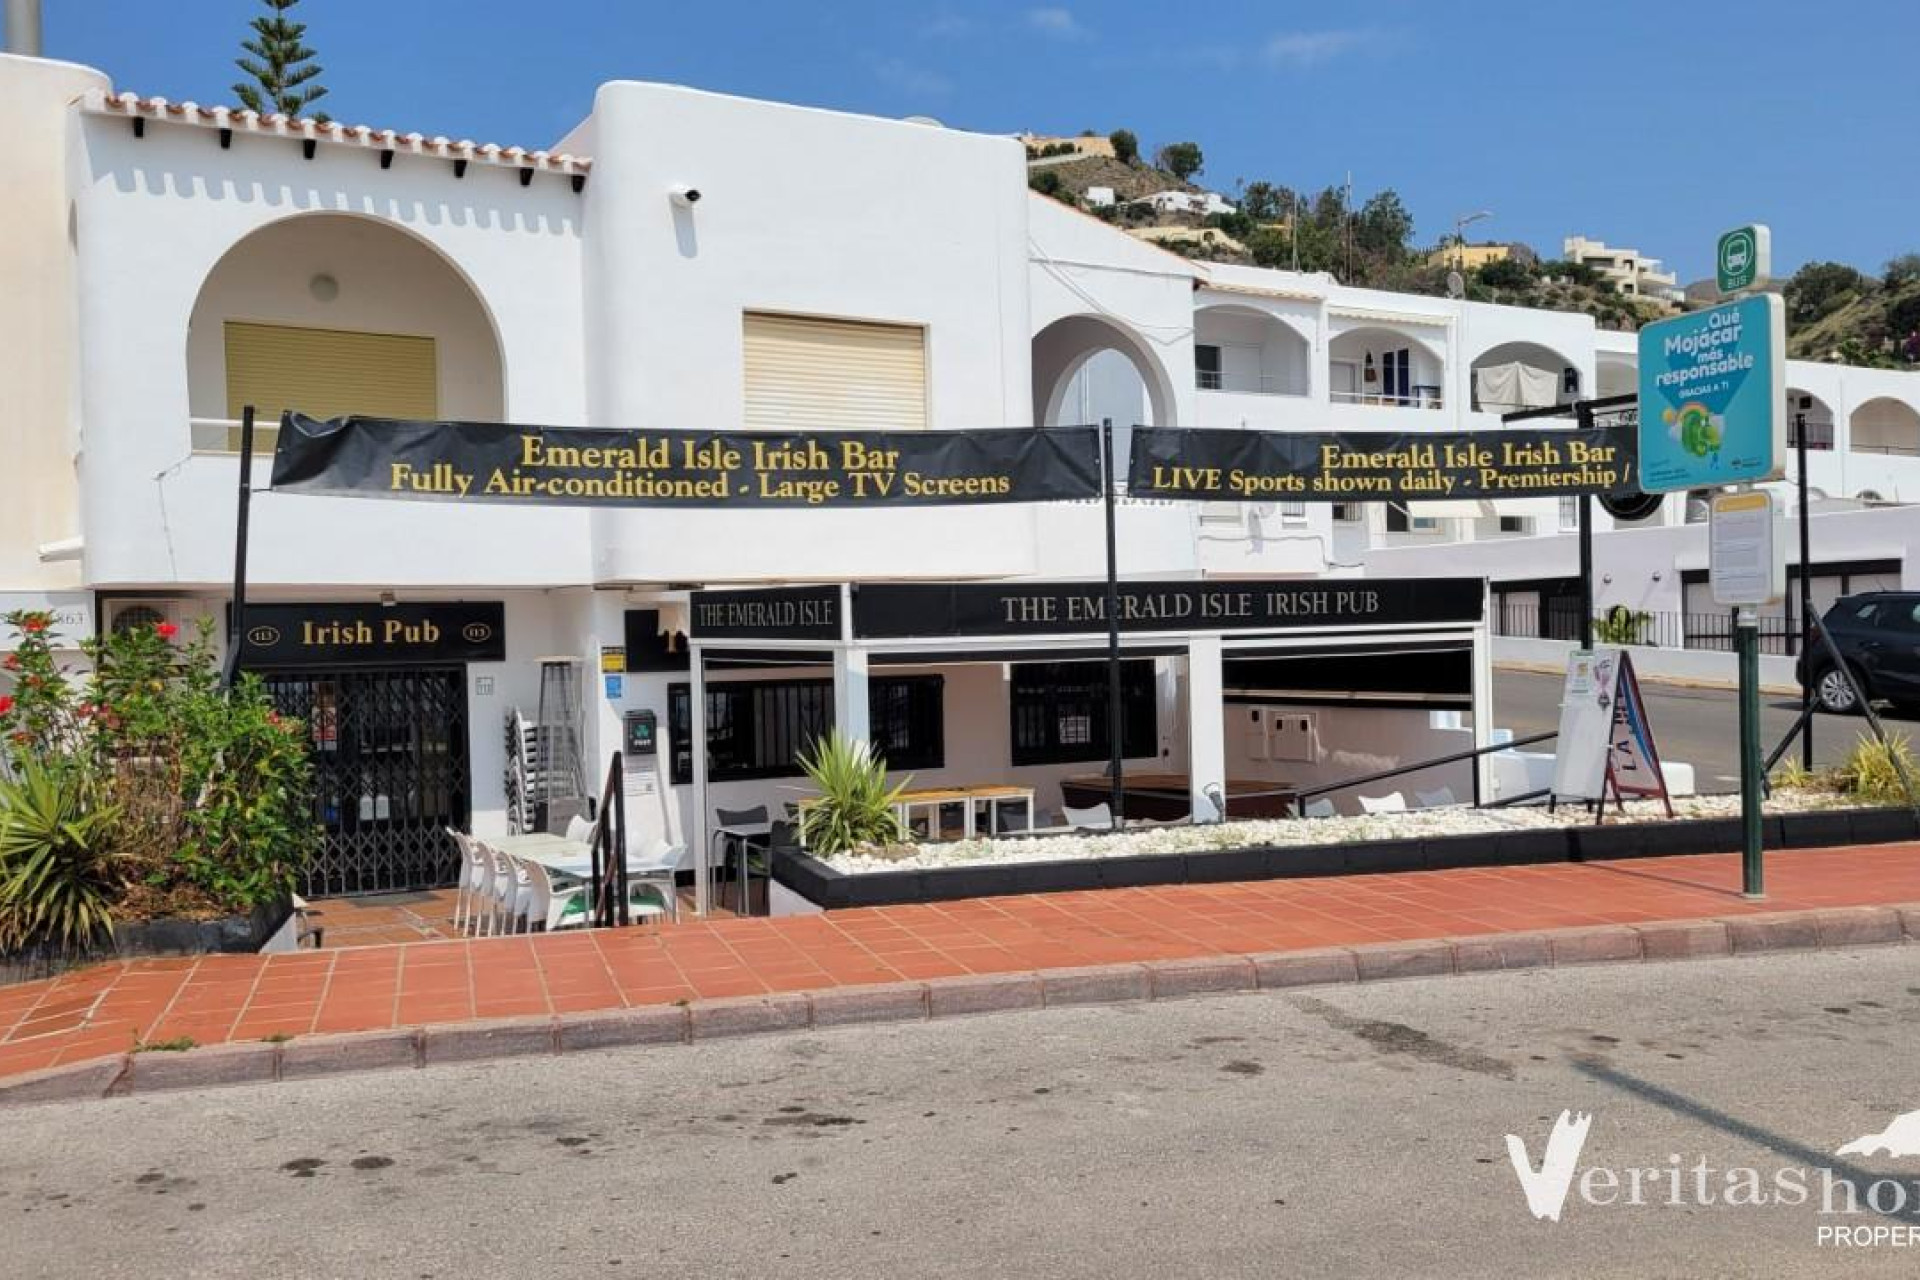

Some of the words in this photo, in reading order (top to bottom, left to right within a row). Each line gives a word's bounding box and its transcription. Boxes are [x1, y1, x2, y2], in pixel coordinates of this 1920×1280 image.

[1727, 276, 1746, 289] BUS
[1708, 307, 1740, 329] Qué
[1664, 325, 1743, 357] Mojácar
[1697, 347, 1724, 364] más
[1656, 351, 1754, 387] responsable
[1678, 386, 1711, 399] GRACIAS
[520, 434, 671, 469] Emerald
[682, 438, 741, 470] Isle
[752, 439, 830, 471] Irish
[840, 440, 899, 471] Bar
[1320, 443, 1436, 469] Emerald
[1443, 441, 1493, 468] Isle
[1502, 440, 1561, 466] Irish
[1566, 440, 1616, 465] Bar
[391, 463, 474, 498] Fully
[484, 468, 731, 498] Air-conditioned
[757, 473, 840, 504] Large
[848, 472, 896, 498] TV
[903, 472, 1011, 496] Screens
[1153, 466, 1222, 490] LIVE
[1229, 469, 1305, 496] Sports
[1313, 469, 1392, 492] shown
[1399, 467, 1455, 495] daily
[1479, 463, 1617, 489] Premiership
[697, 603, 725, 627] THE
[728, 601, 796, 627] EMERALD
[800, 600, 833, 626] ISLE
[1000, 596, 1058, 622] THE
[1201, 593, 1252, 618] ISLE
[1267, 591, 1329, 616] IRISH
[1336, 591, 1379, 614] PUB
[302, 619, 373, 645] Irish
[383, 618, 441, 644] Pub
